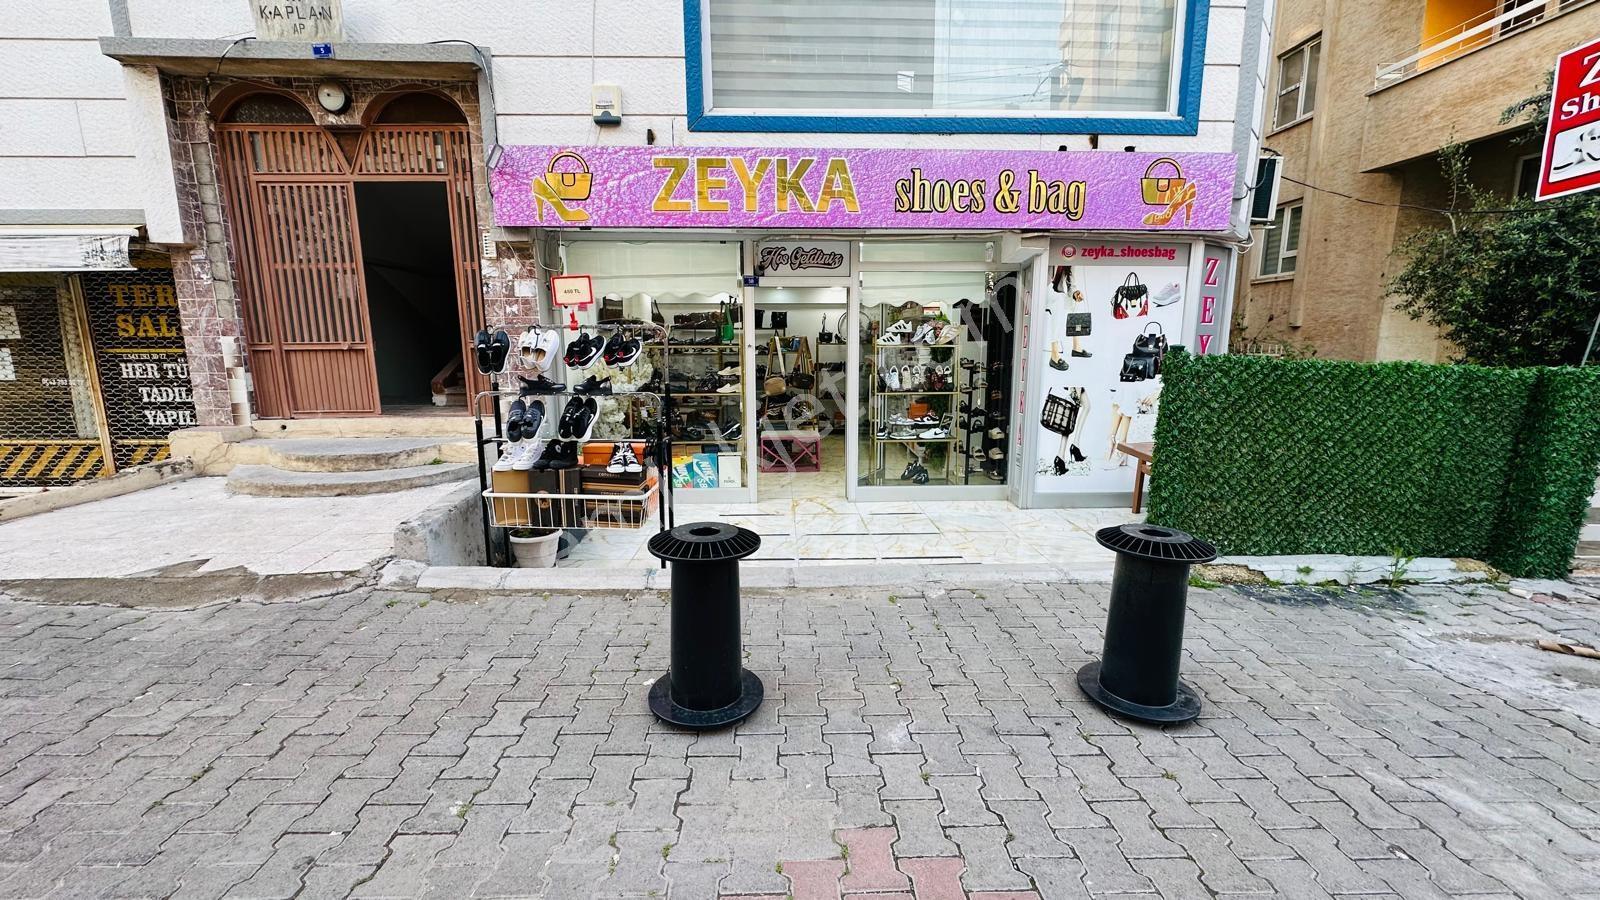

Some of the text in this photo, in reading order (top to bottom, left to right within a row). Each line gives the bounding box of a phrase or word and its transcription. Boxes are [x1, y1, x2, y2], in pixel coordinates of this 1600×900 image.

[259, 5, 333, 20] KAPLAN
[293, 23, 306, 35] AP
[652, 156, 861, 213] ZEYKA
[894, 168, 1086, 221] shoes & bag
[1081, 245, 1176, 260] zeyka_shoesbag
[116, 313, 177, 337] SAL
[120, 358, 188, 378] HER TÜ
